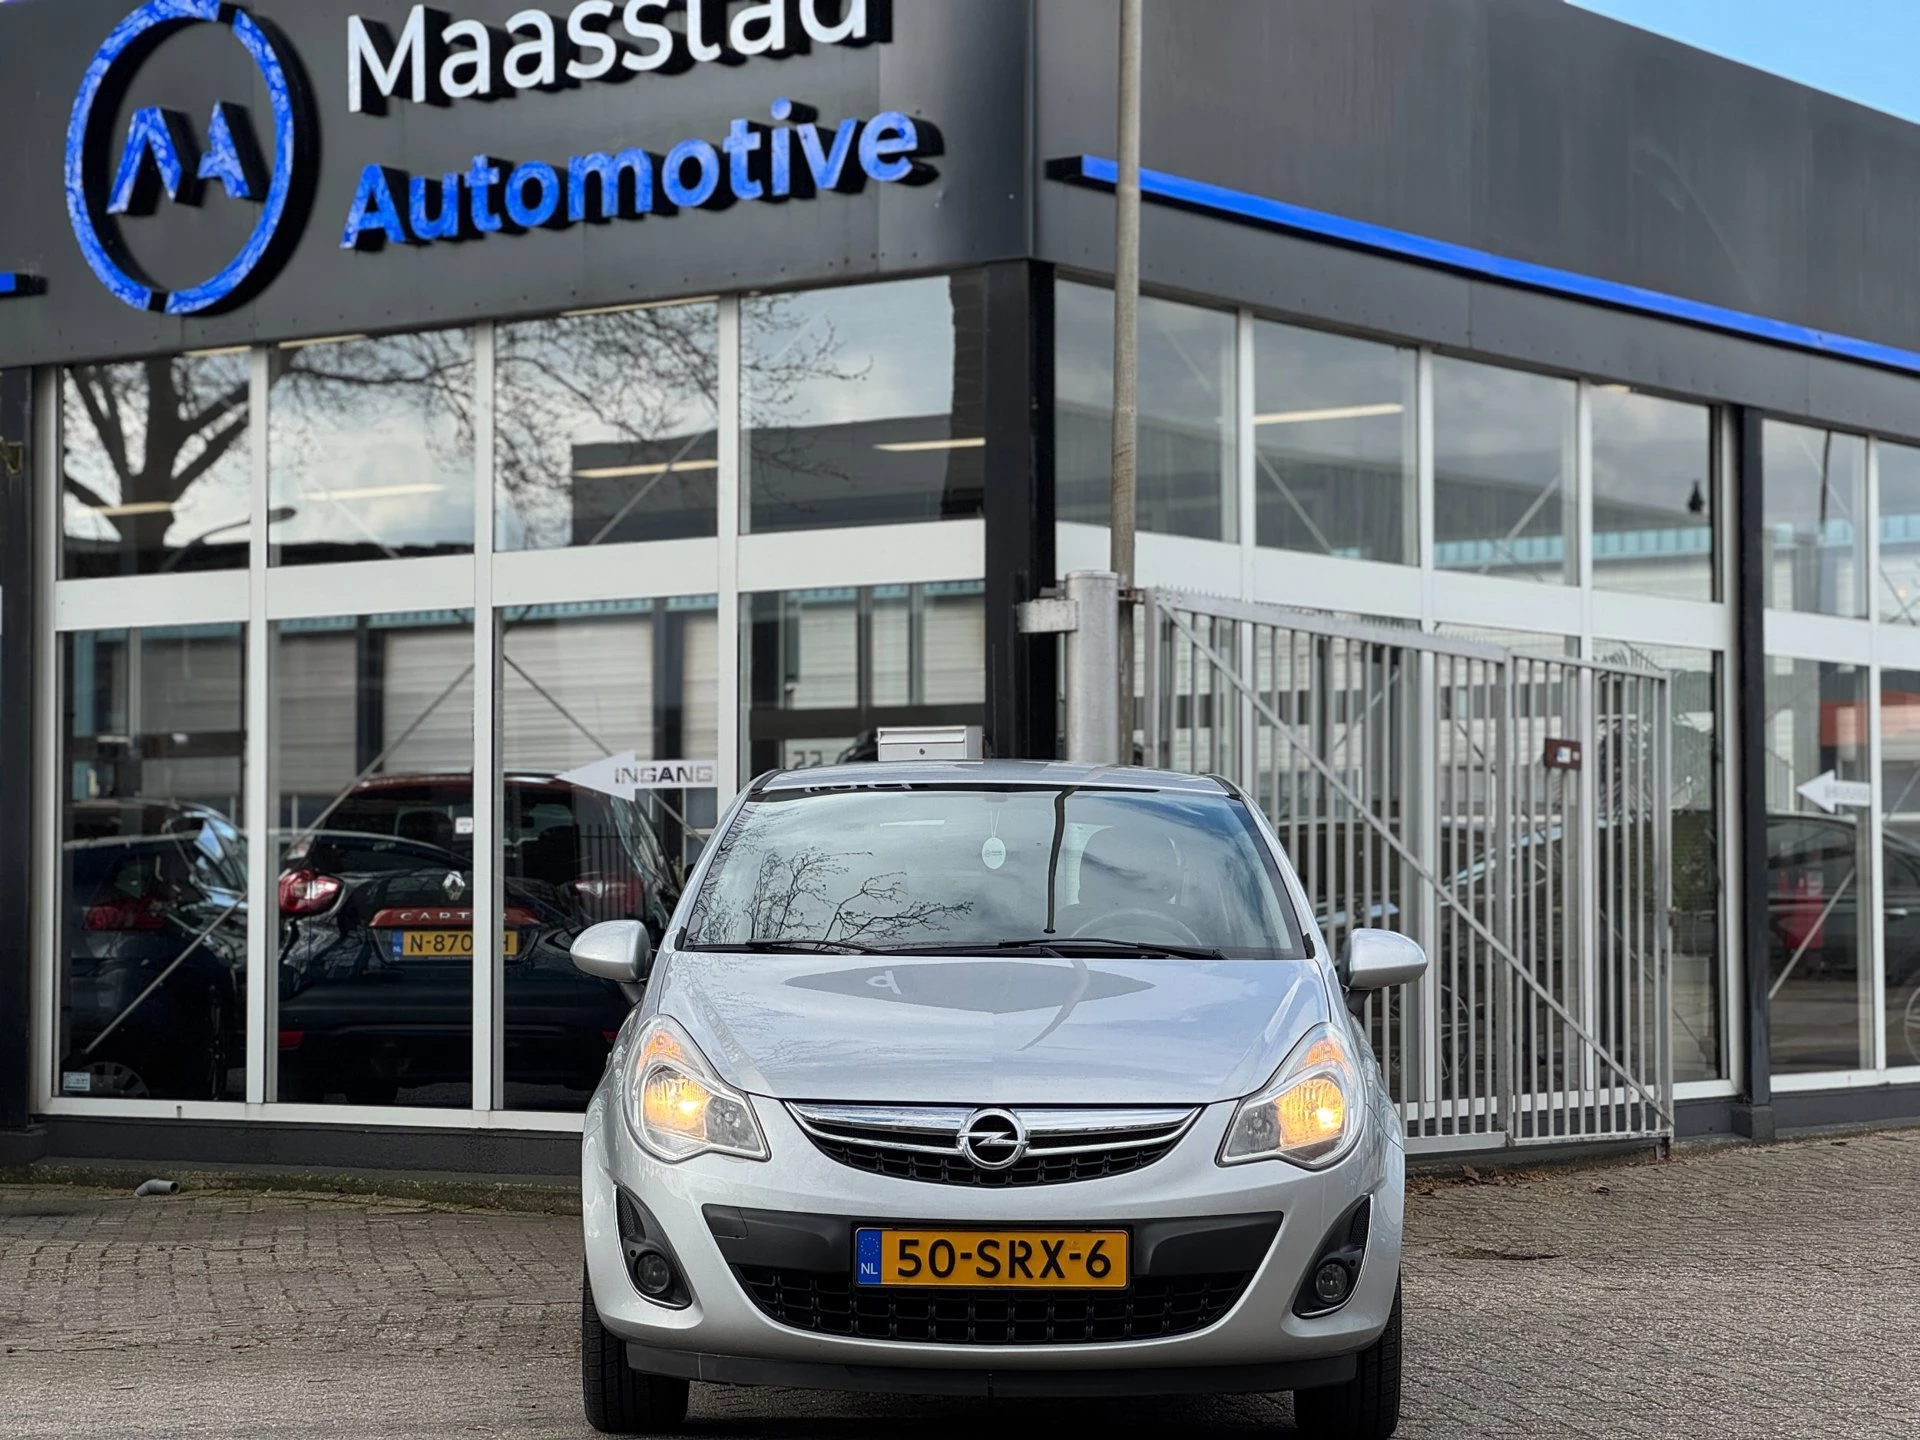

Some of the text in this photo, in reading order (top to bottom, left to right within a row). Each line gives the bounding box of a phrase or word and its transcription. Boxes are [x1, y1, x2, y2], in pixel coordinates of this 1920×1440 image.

[340, 97, 918, 249] Automotive
[614, 765, 713, 784] INGANG
[861, 1263, 878, 1275] NL
[897, 1239, 1112, 1279] 50-SRX-6
